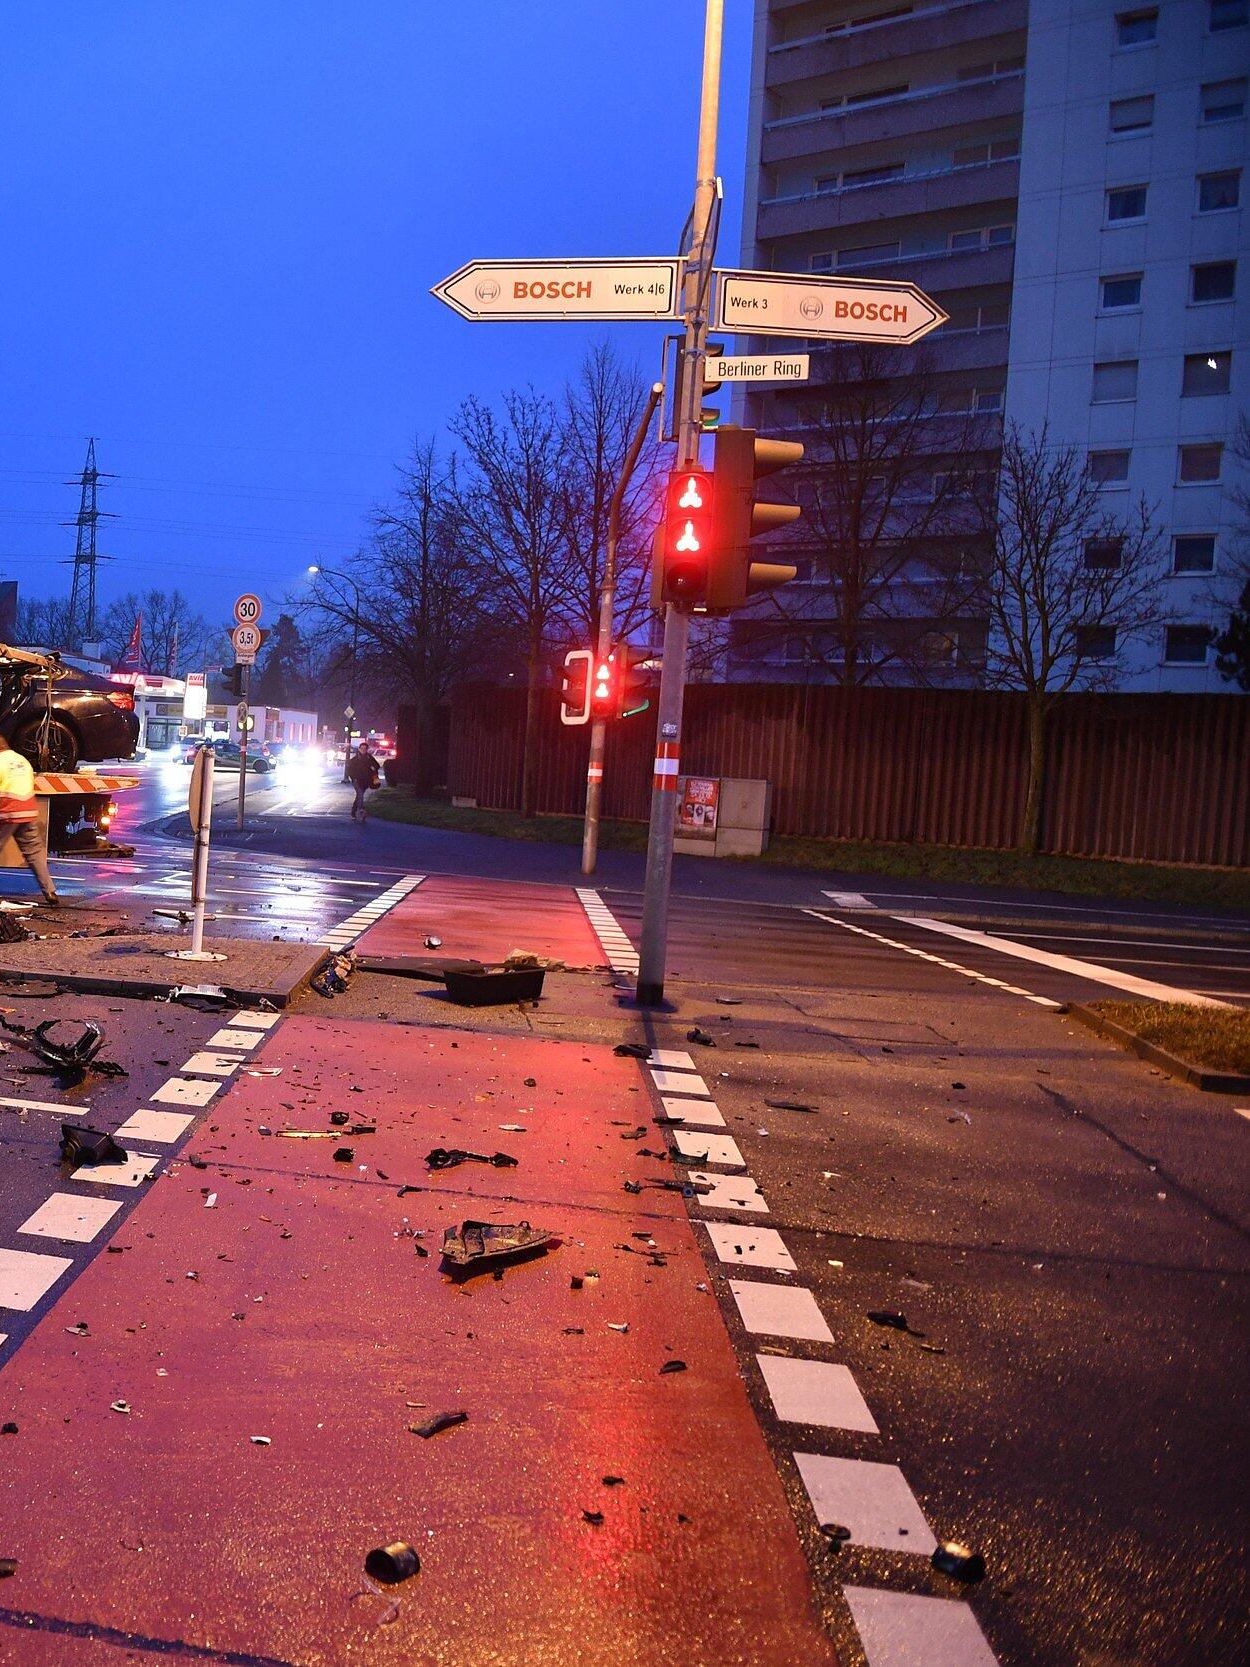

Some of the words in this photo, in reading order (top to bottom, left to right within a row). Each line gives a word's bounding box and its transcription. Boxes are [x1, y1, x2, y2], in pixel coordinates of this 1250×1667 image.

[513, 281, 592, 299] BOSCH
[614, 284, 644, 295] Werk
[730, 296, 758, 309] Werk
[761, 299, 768, 310] 3
[835, 300, 908, 323] BOSCH
[718, 361, 768, 377] Berliner
[773, 360, 802, 378] Ring
[240, 602, 256, 618] 30
[239, 631, 254, 646] 3,5t
[111, 672, 145, 687] AVIA
